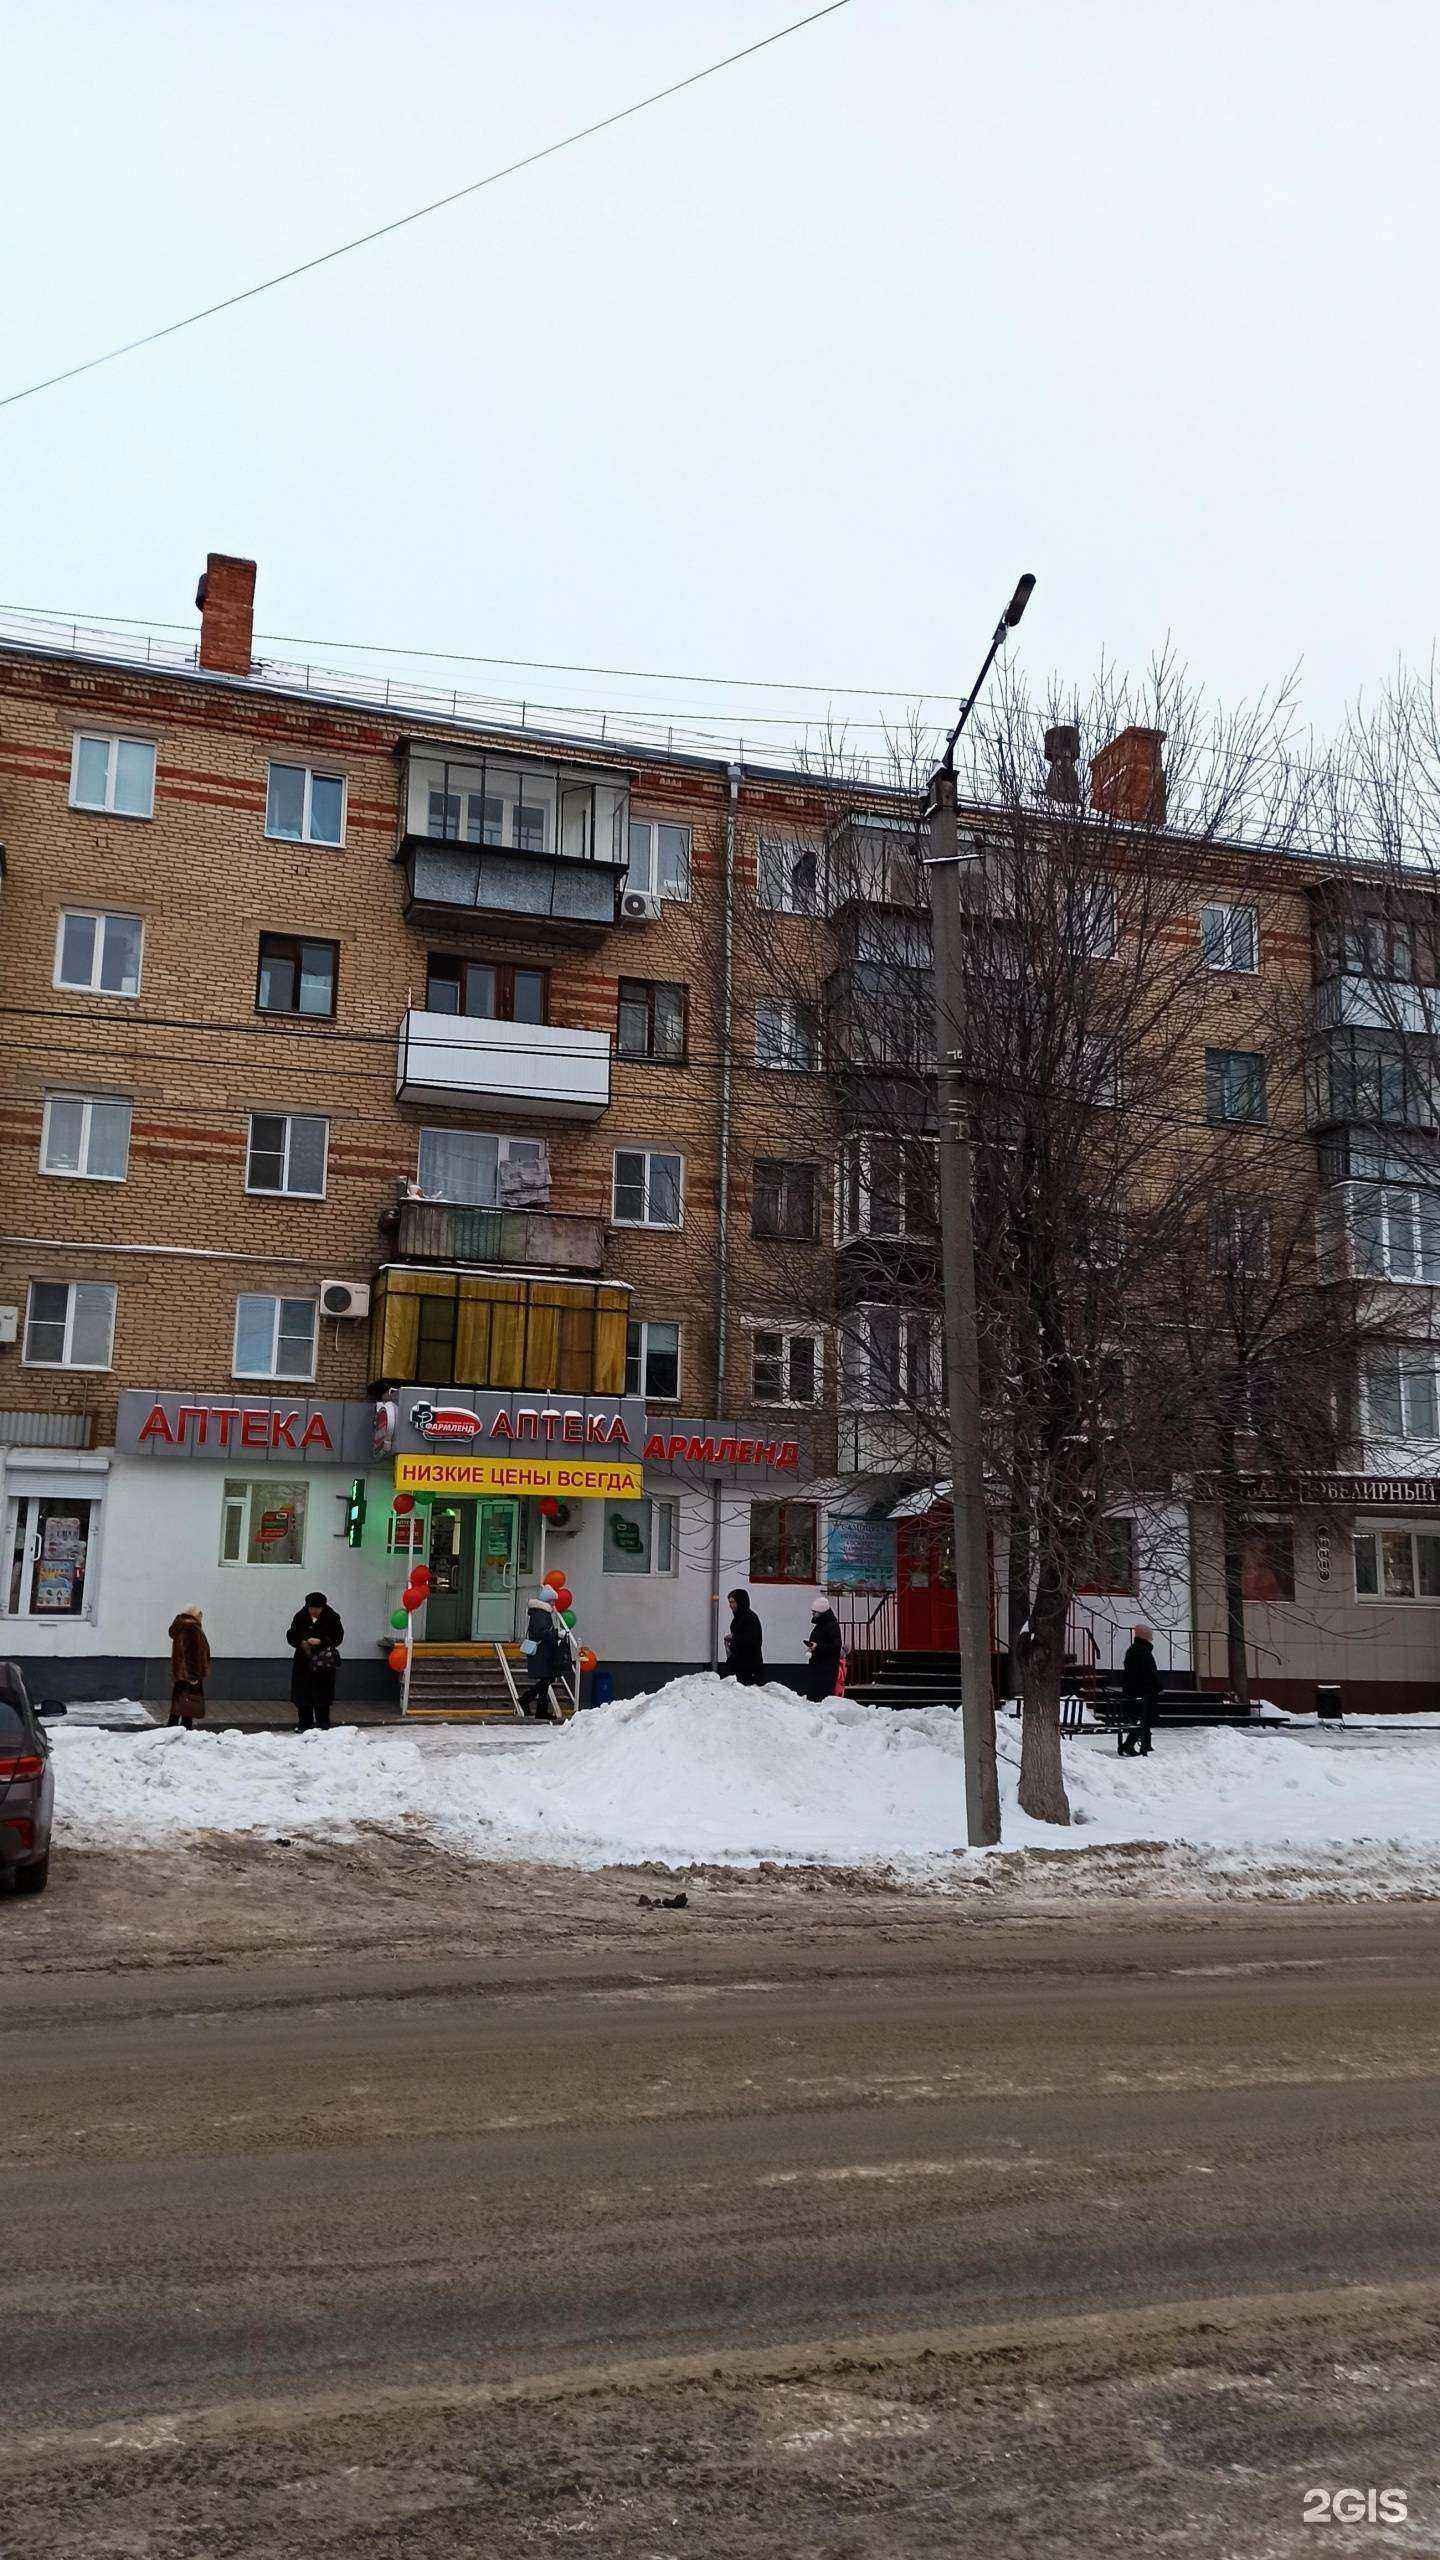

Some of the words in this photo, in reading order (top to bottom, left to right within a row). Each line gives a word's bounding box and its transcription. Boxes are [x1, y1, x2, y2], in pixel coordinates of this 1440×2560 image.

[138, 1404, 333, 1449] АПТЕКА
[426, 1422, 475, 1433] ФАРМЛЕНД
[489, 1409, 631, 1444] АПТЕКА
[643, 1433, 800, 1471] АРМЛЕНД
[402, 1464, 484, 1483] НИЗКИЕ
[491, 1468, 551, 1486] ЦЕНЫ
[557, 1471, 636, 1491] ВСЕГДА
